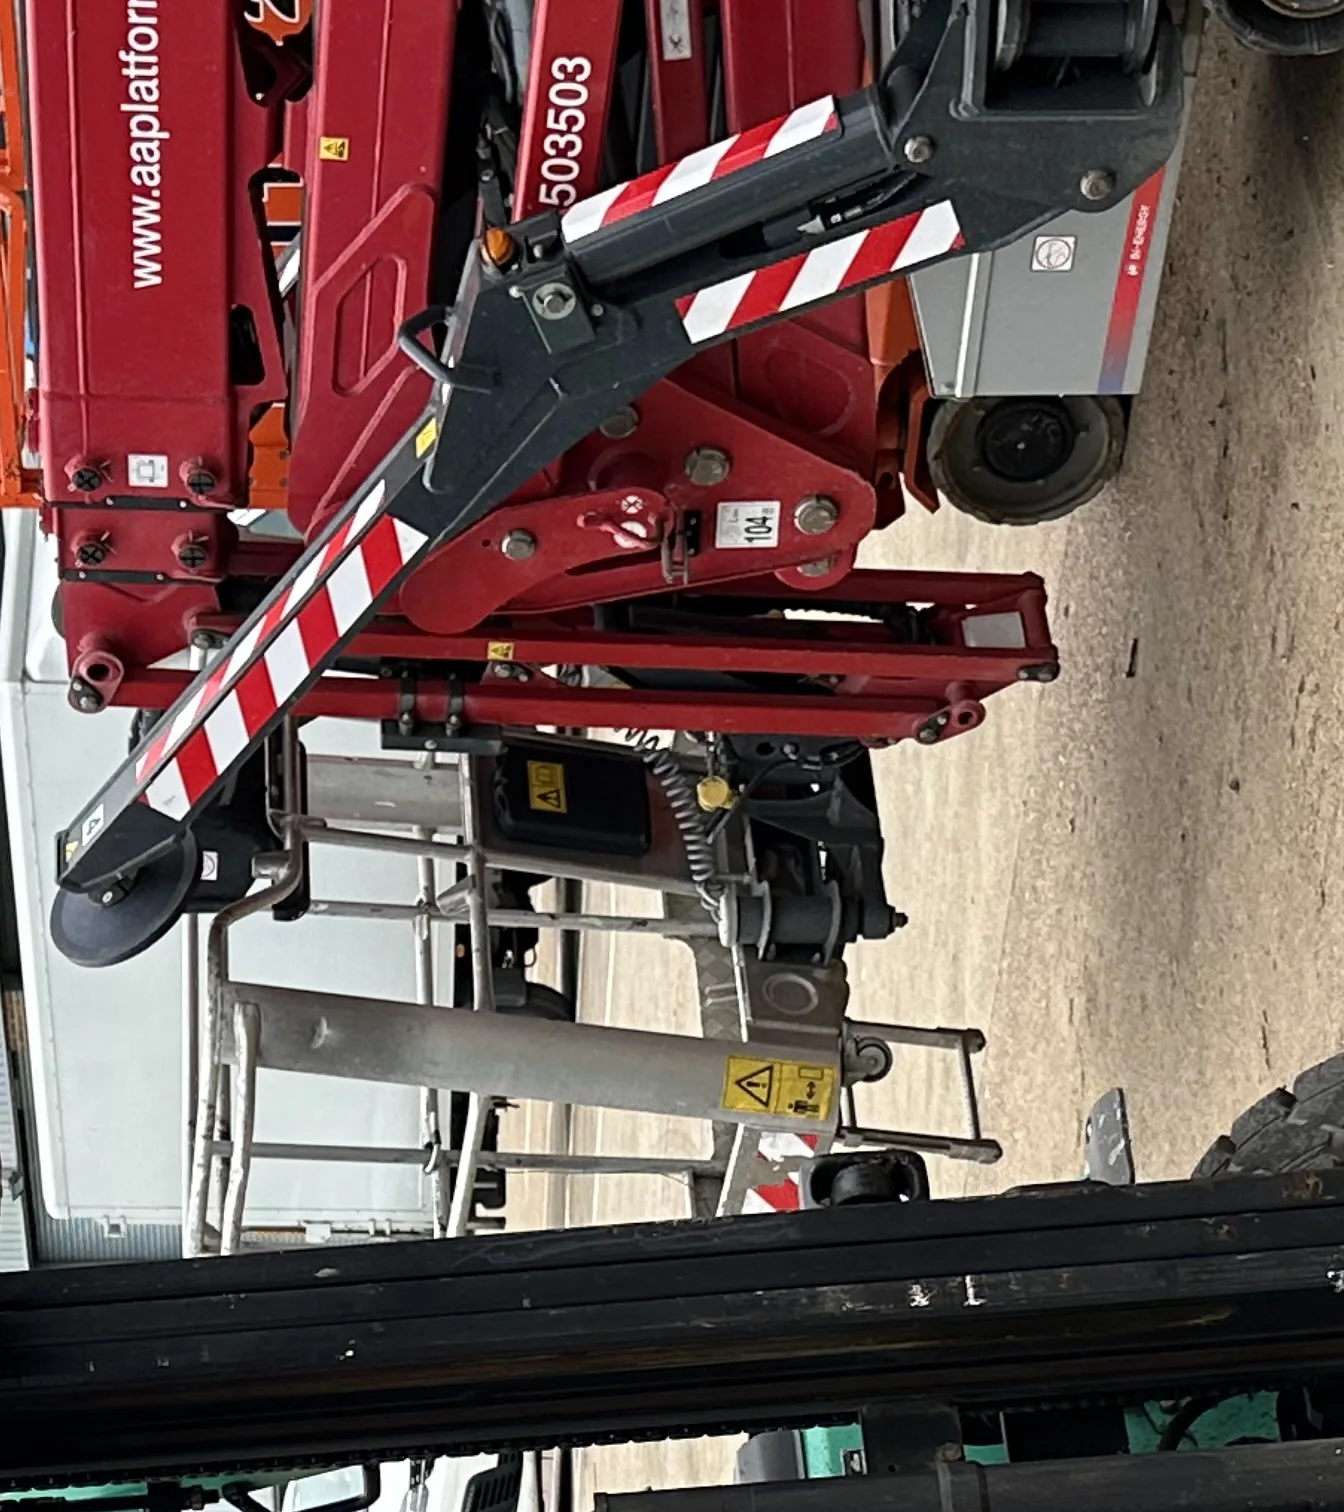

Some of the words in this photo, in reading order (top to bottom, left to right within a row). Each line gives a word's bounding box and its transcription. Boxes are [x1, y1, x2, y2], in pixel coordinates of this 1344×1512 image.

[118, 0, 171, 289] www.aaplatfor
[538, 55, 593, 207] 503503
[742, 516, 774, 543] 104
